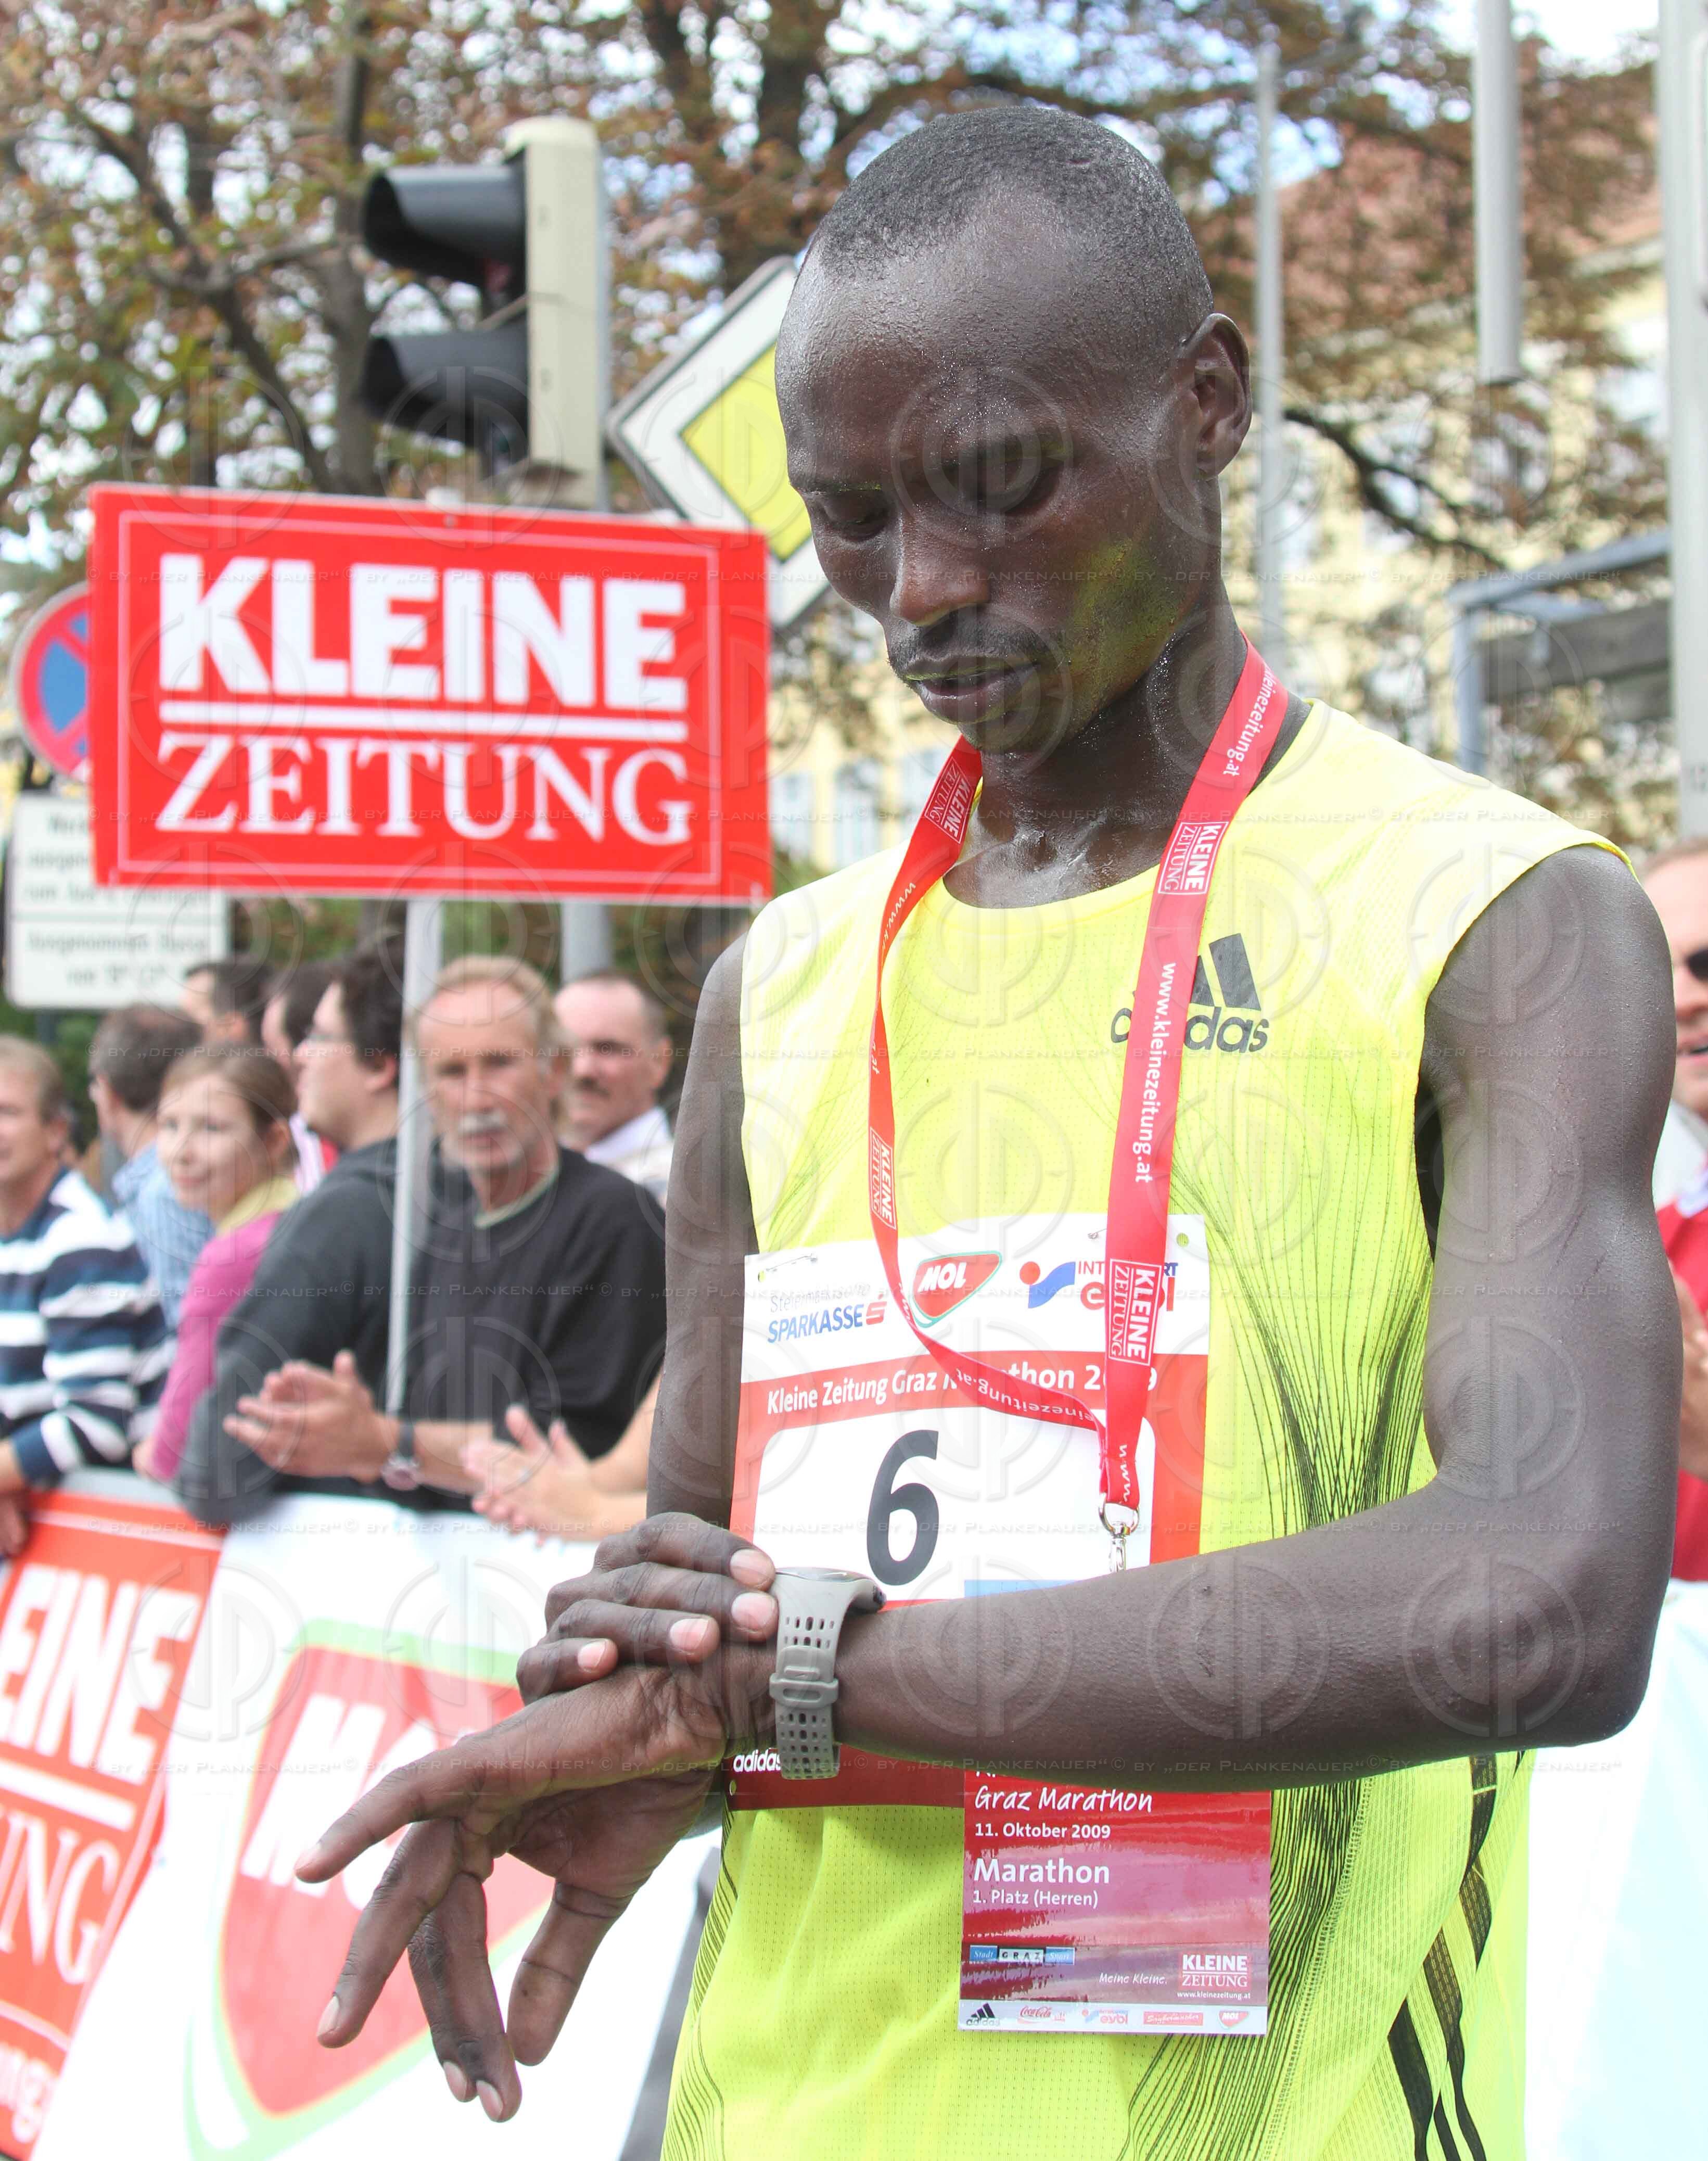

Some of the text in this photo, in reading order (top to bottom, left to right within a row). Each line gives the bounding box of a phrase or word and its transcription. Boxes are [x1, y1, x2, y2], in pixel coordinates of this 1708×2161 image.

[160, 554, 687, 711] KLEINE
[155, 731, 694, 845] ZEITUNG
[929, 762, 960, 824] ZEITUNG
[943, 778, 972, 838] KLEINE
[1164, 826, 1199, 892] ZEITUNG
[1184, 823, 1221, 891] KLEINE
[1133, 962, 1176, 1183] www.kleinezeitung.at
[881, 1144, 893, 1224] KLEINE
[918, 1262, 967, 1292] MOL
[767, 1303, 864, 1343] SPARKASSE
[1111, 1265, 1129, 1356] ZEITUNG
[1127, 1268, 1156, 1359] KLEINE
[768, 1387, 818, 1415] Kleine
[822, 1378, 888, 1405] Zeitung
[892, 1369, 937, 1395] Graz
[866, 1430, 939, 1585] 6
[975, 1785, 1153, 1813] Graz Marathon
[975, 1822, 1111, 1839] 11. Oktober 2009
[973, 1858, 1110, 1884] Marathon
[973, 1889, 1098, 1909] 1. Platz (Herren)
[1099, 1973, 1129, 1984] Meine
[1181, 1975, 1248, 1987] ZEITUNG
[1182, 1954, 1247, 1971] KLEINE
[1177, 1991, 1251, 2000] www.kleinezeitung.at
